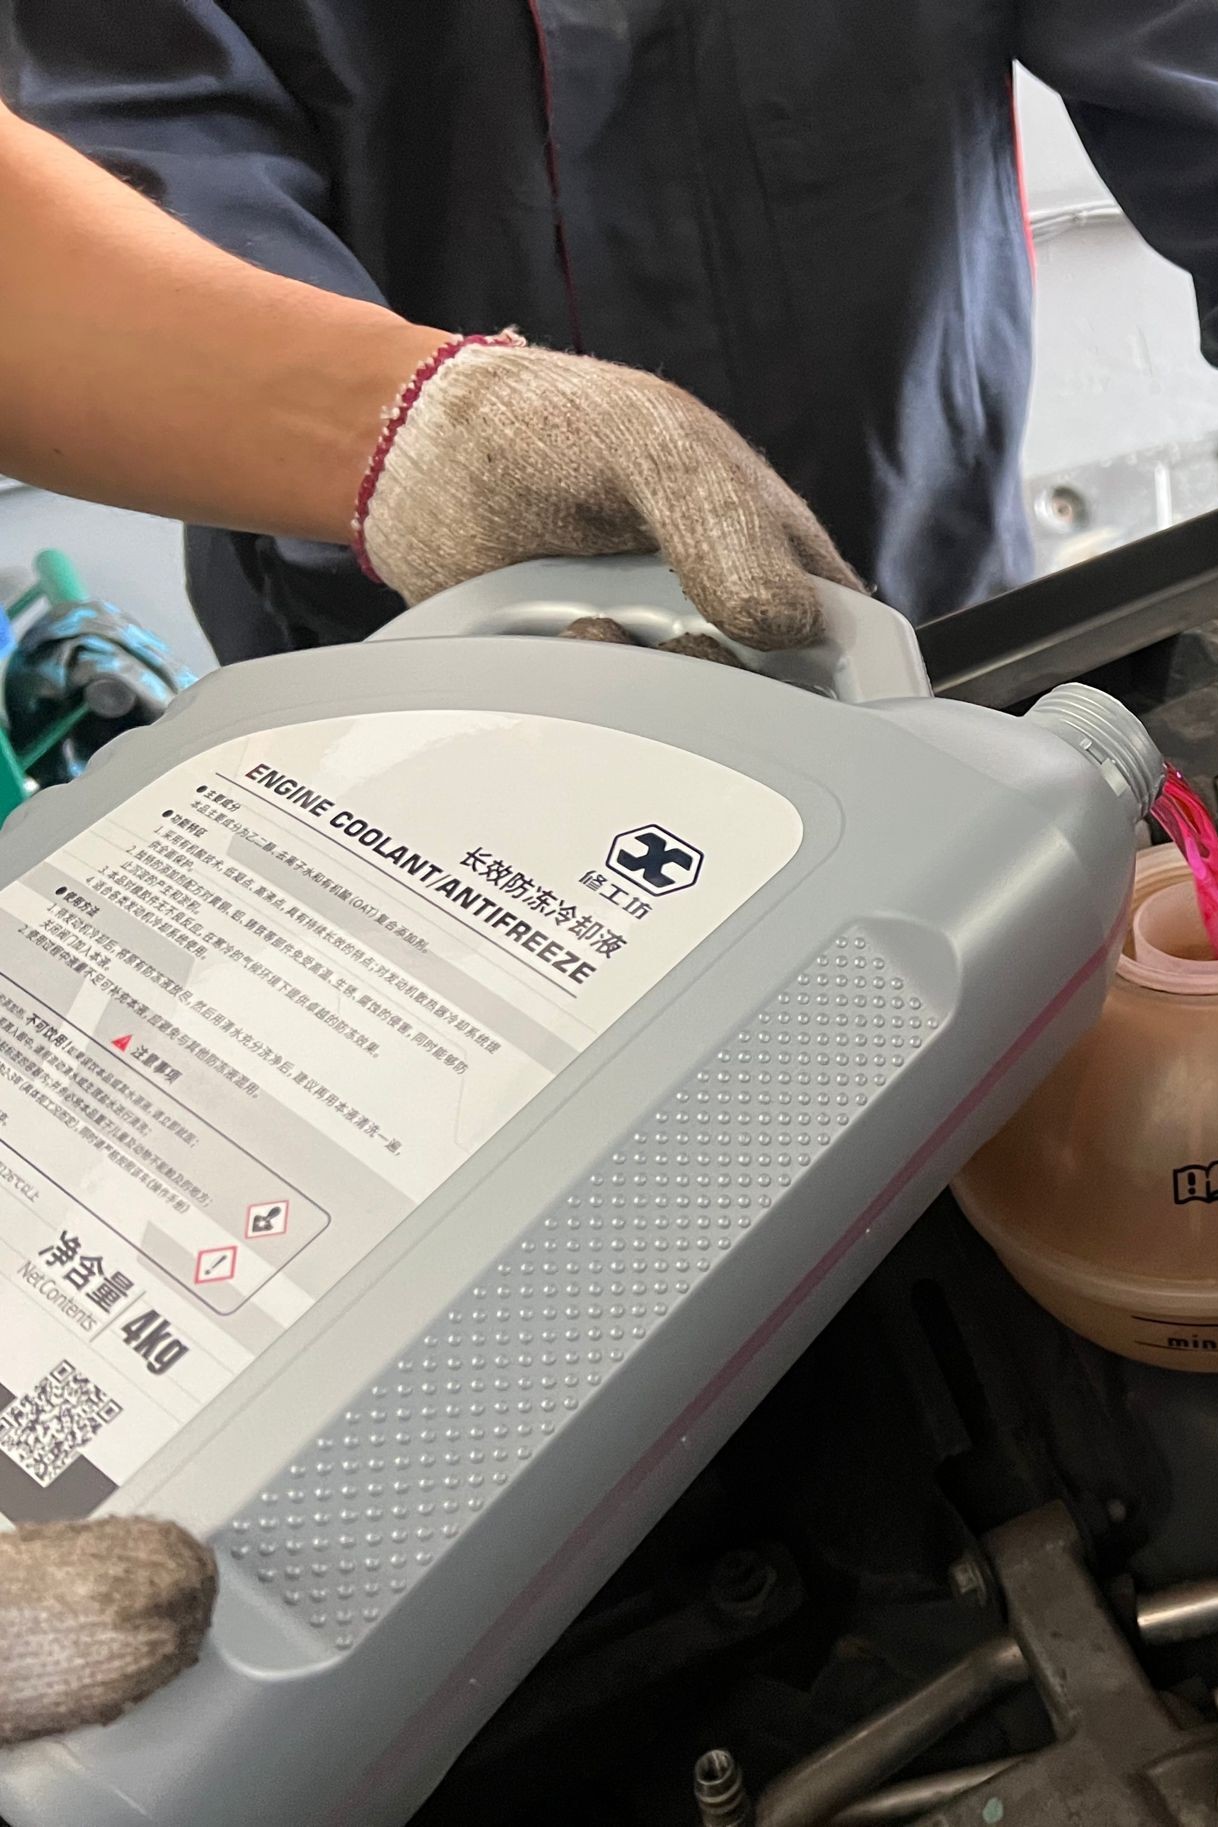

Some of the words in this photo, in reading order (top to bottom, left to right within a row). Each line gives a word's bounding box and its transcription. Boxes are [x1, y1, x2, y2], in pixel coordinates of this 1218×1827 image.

[244, 763, 335, 817] ENGINE
[329, 810, 597, 984] COOLANT/ANTIFREEZE
[458, 846, 627, 959] 长效防冻冷却液
[577, 869, 653, 920] 修工坊
[129, 1044, 182, 1084] 注意事项
[37, 1229, 134, 1314] 净含量
[120, 1308, 190, 1376] 4kg
[1168, 1335, 1217, 1349] min
